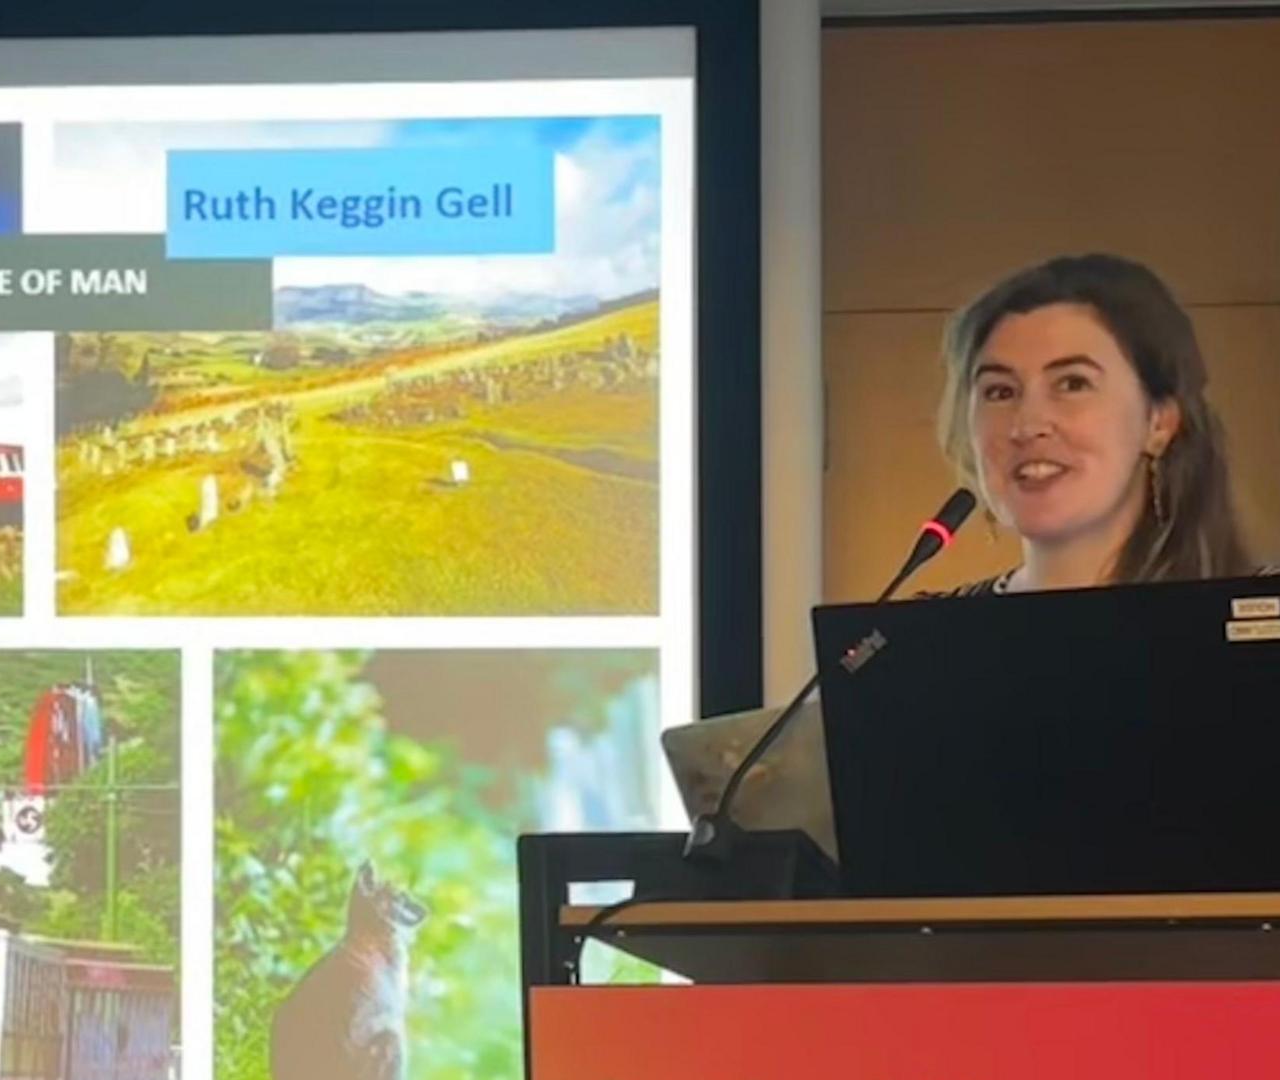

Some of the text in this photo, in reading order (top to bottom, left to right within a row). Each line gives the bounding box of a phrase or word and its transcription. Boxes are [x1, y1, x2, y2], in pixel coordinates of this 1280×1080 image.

[183, 184, 513, 228] Ruth Keggin Gell
[20, 269, 62, 295] OF
[70, 269, 147, 295] MAN
